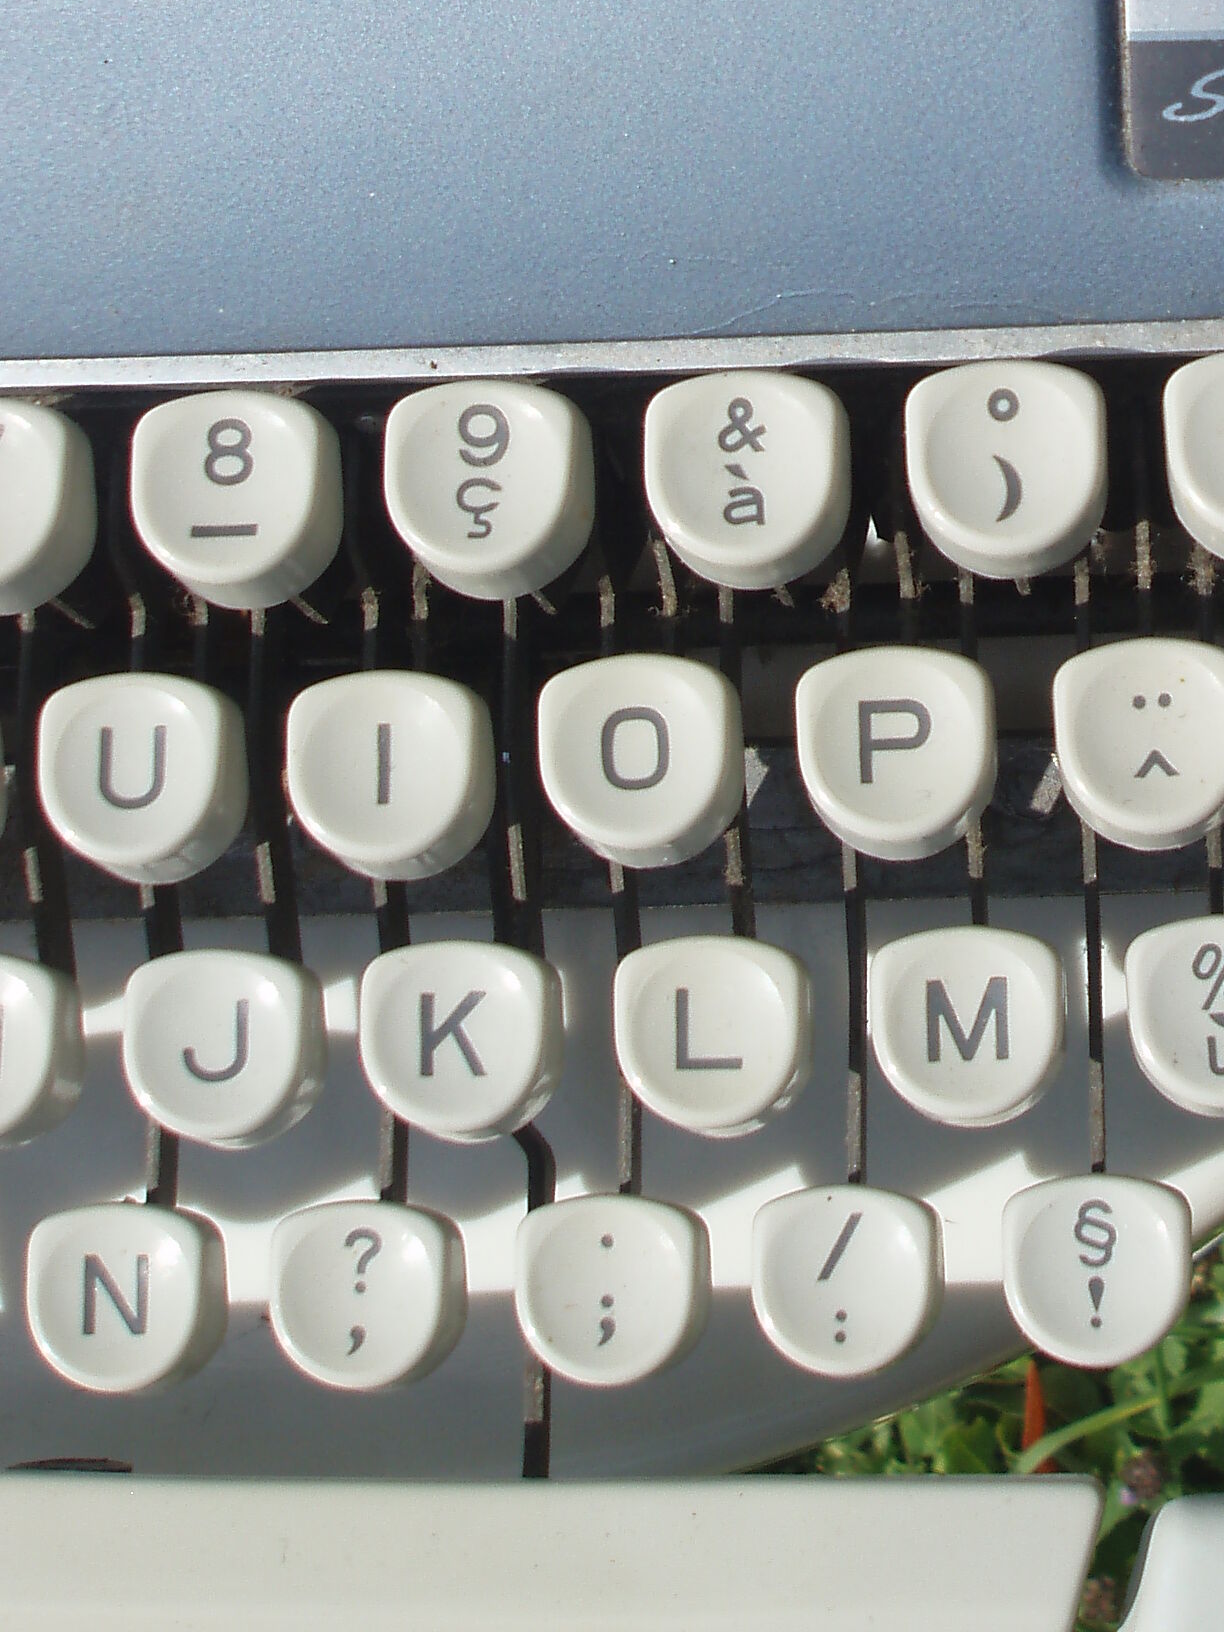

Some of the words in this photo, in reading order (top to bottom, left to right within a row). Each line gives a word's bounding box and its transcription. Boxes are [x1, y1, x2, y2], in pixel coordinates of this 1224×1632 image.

[203, 419, 253, 486] 8
[458, 405, 509, 468] 9
[718, 398, 766, 453] &
[456, 478, 501, 539] ç
[723, 464, 765, 525] à
[993, 456, 1022, 522] )
[97, 726, 165, 810] U
[376, 724, 391, 805] I
[600, 707, 669, 791] O
[858, 699, 930, 784] P
[183, 998, 249, 1082] J
[419, 992, 486, 1078] K
[674, 988, 742, 1072] L
[925, 977, 1009, 1064] M
[344, 1229, 381, 1294] ?
[817, 1213, 861, 1282] /
[1074, 1200, 1116, 1268] §
[81, 1255, 147, 1337] N
[598, 1295, 615, 1347] ;
[834, 1310, 847, 1344] :
[1088, 1277, 1104, 1328] !
[347, 1326, 365, 1355] ,
